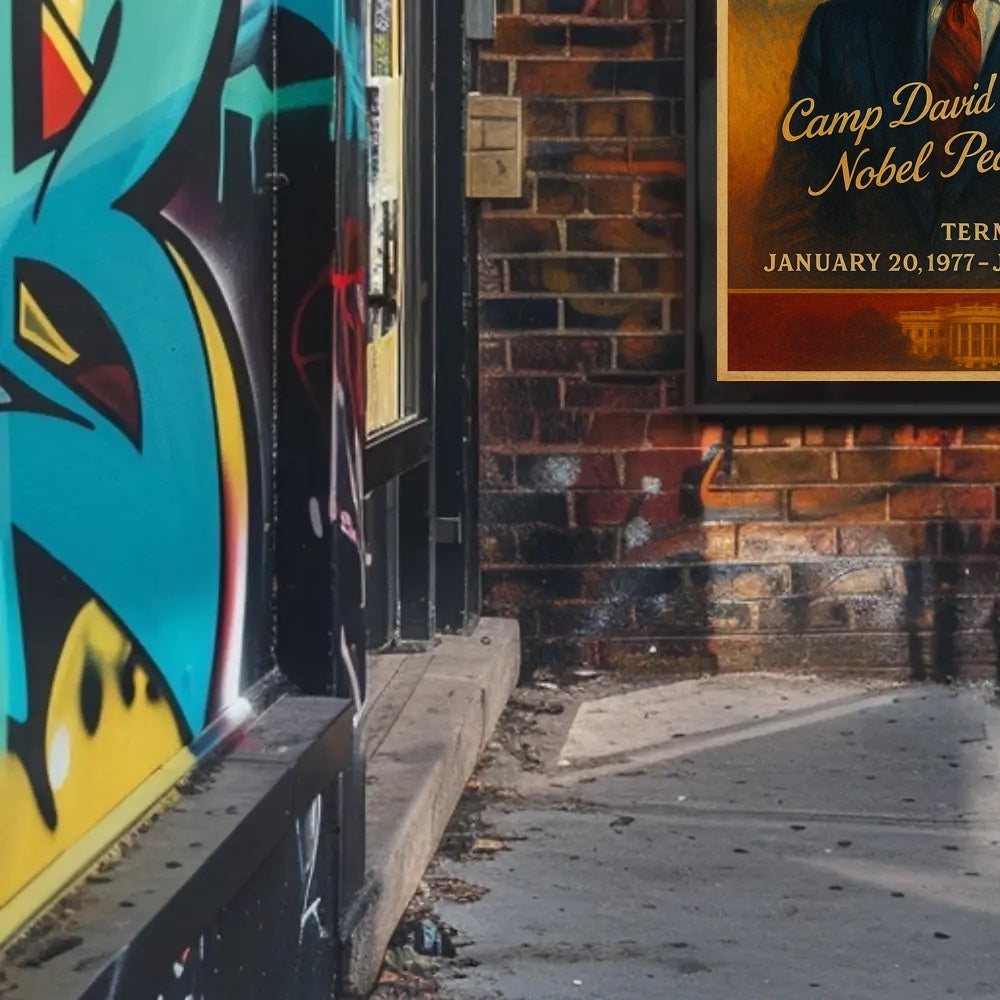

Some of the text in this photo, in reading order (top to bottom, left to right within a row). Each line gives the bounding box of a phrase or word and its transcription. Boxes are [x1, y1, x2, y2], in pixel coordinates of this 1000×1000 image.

[781, 97, 883, 146] Camp
[889, 73, 998, 128] David
[807, 141, 934, 197] Nobel
[763, 253, 880, 272] JANUARY
